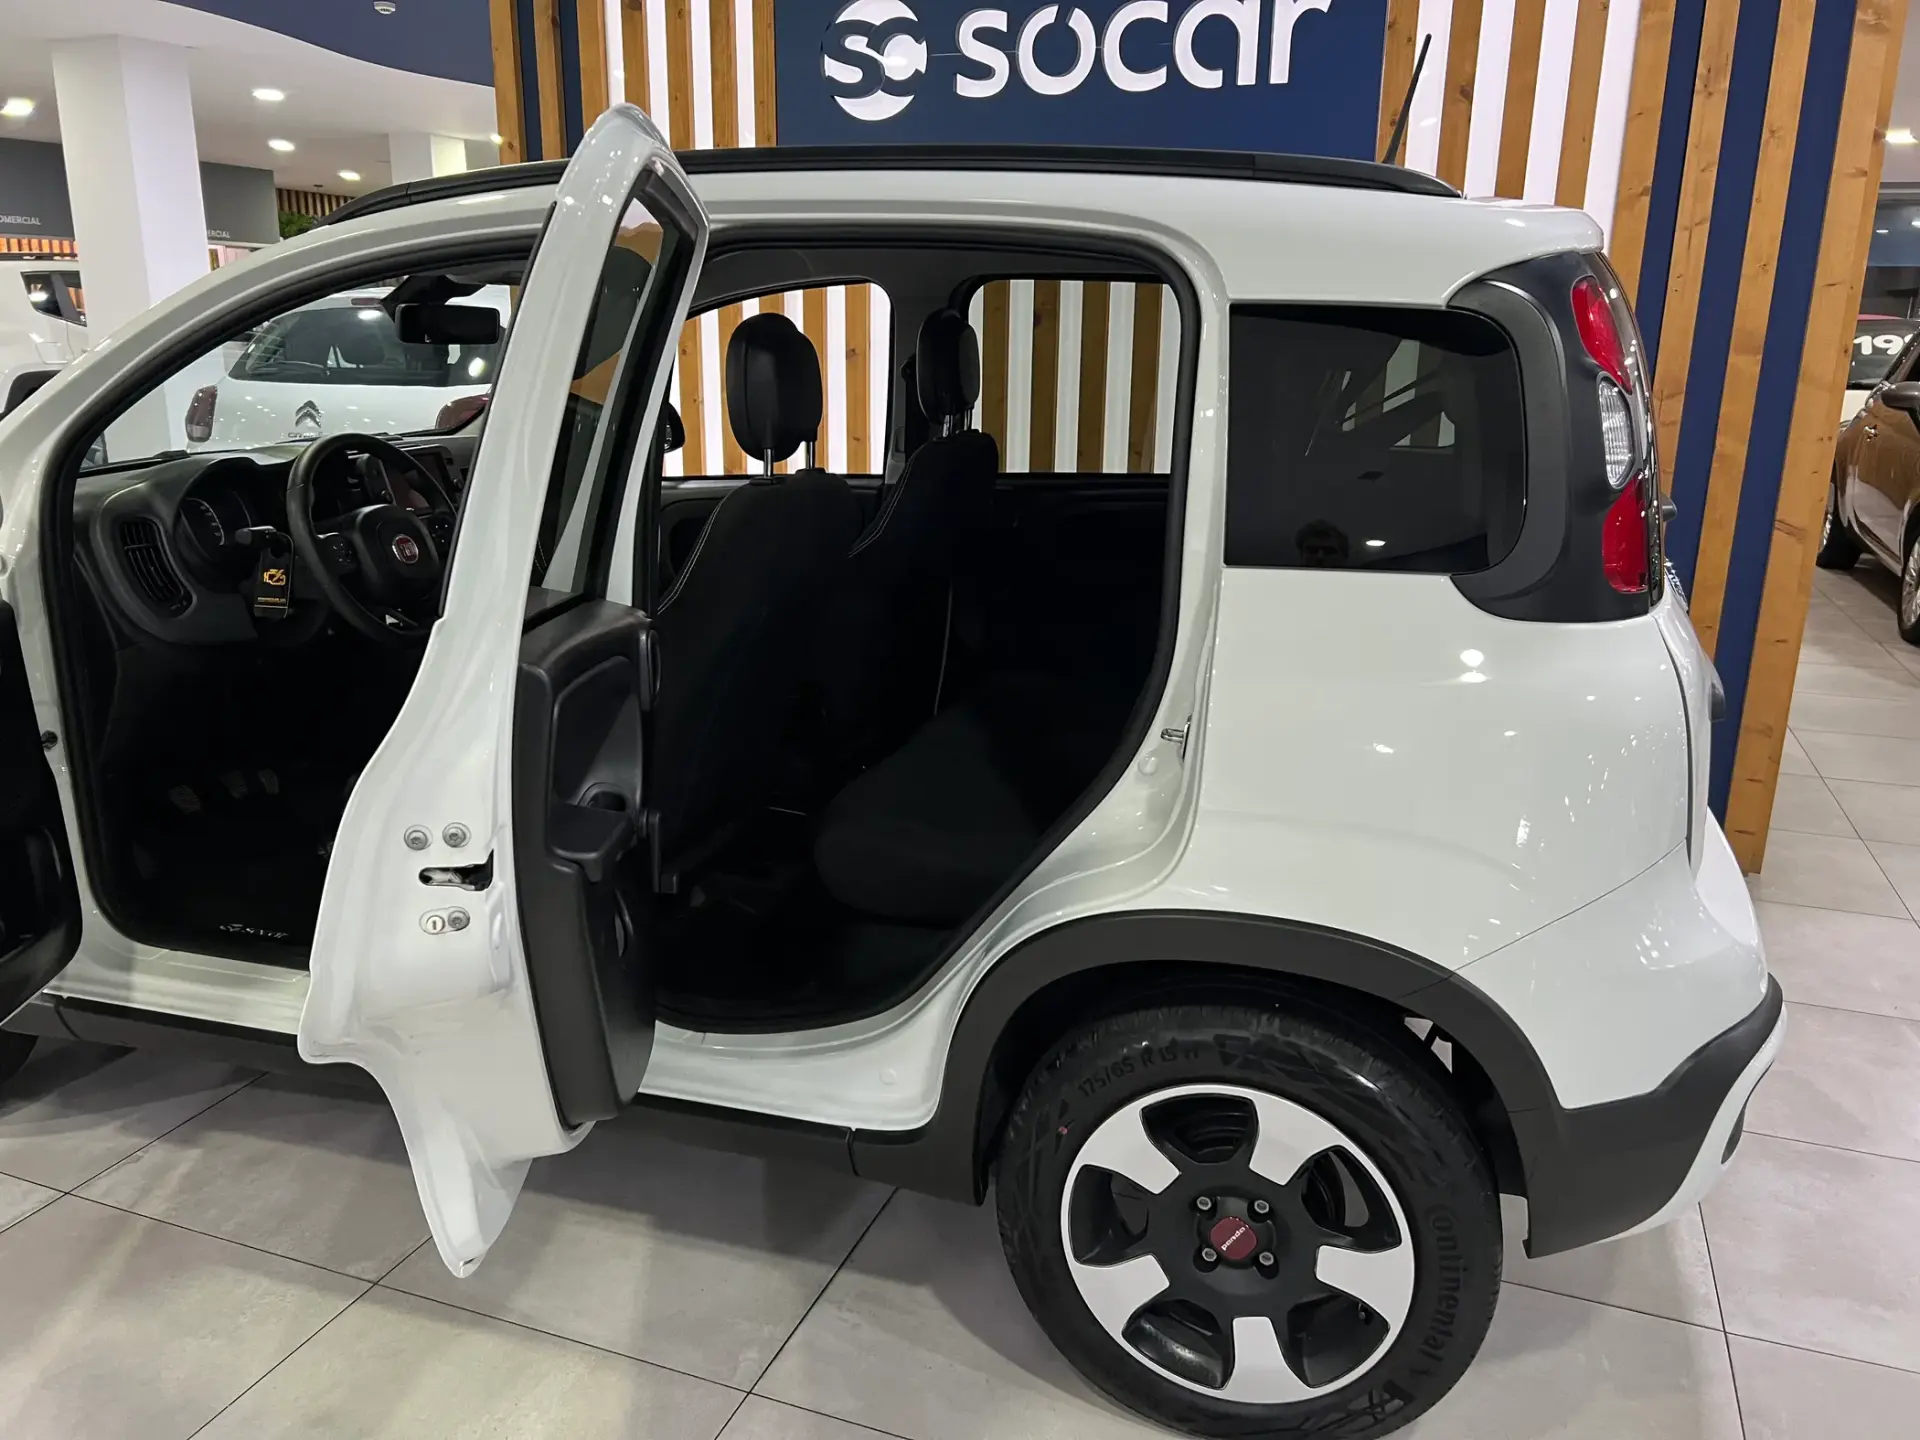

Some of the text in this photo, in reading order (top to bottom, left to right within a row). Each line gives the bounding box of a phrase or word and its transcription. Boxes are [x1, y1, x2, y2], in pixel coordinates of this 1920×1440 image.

[955, 0, 1331, 98] socar
[1077, 1054, 1135, 1098] 175/65
[1140, 1044, 1155, 1068] R
[1220, 1226, 1246, 1251] panda
